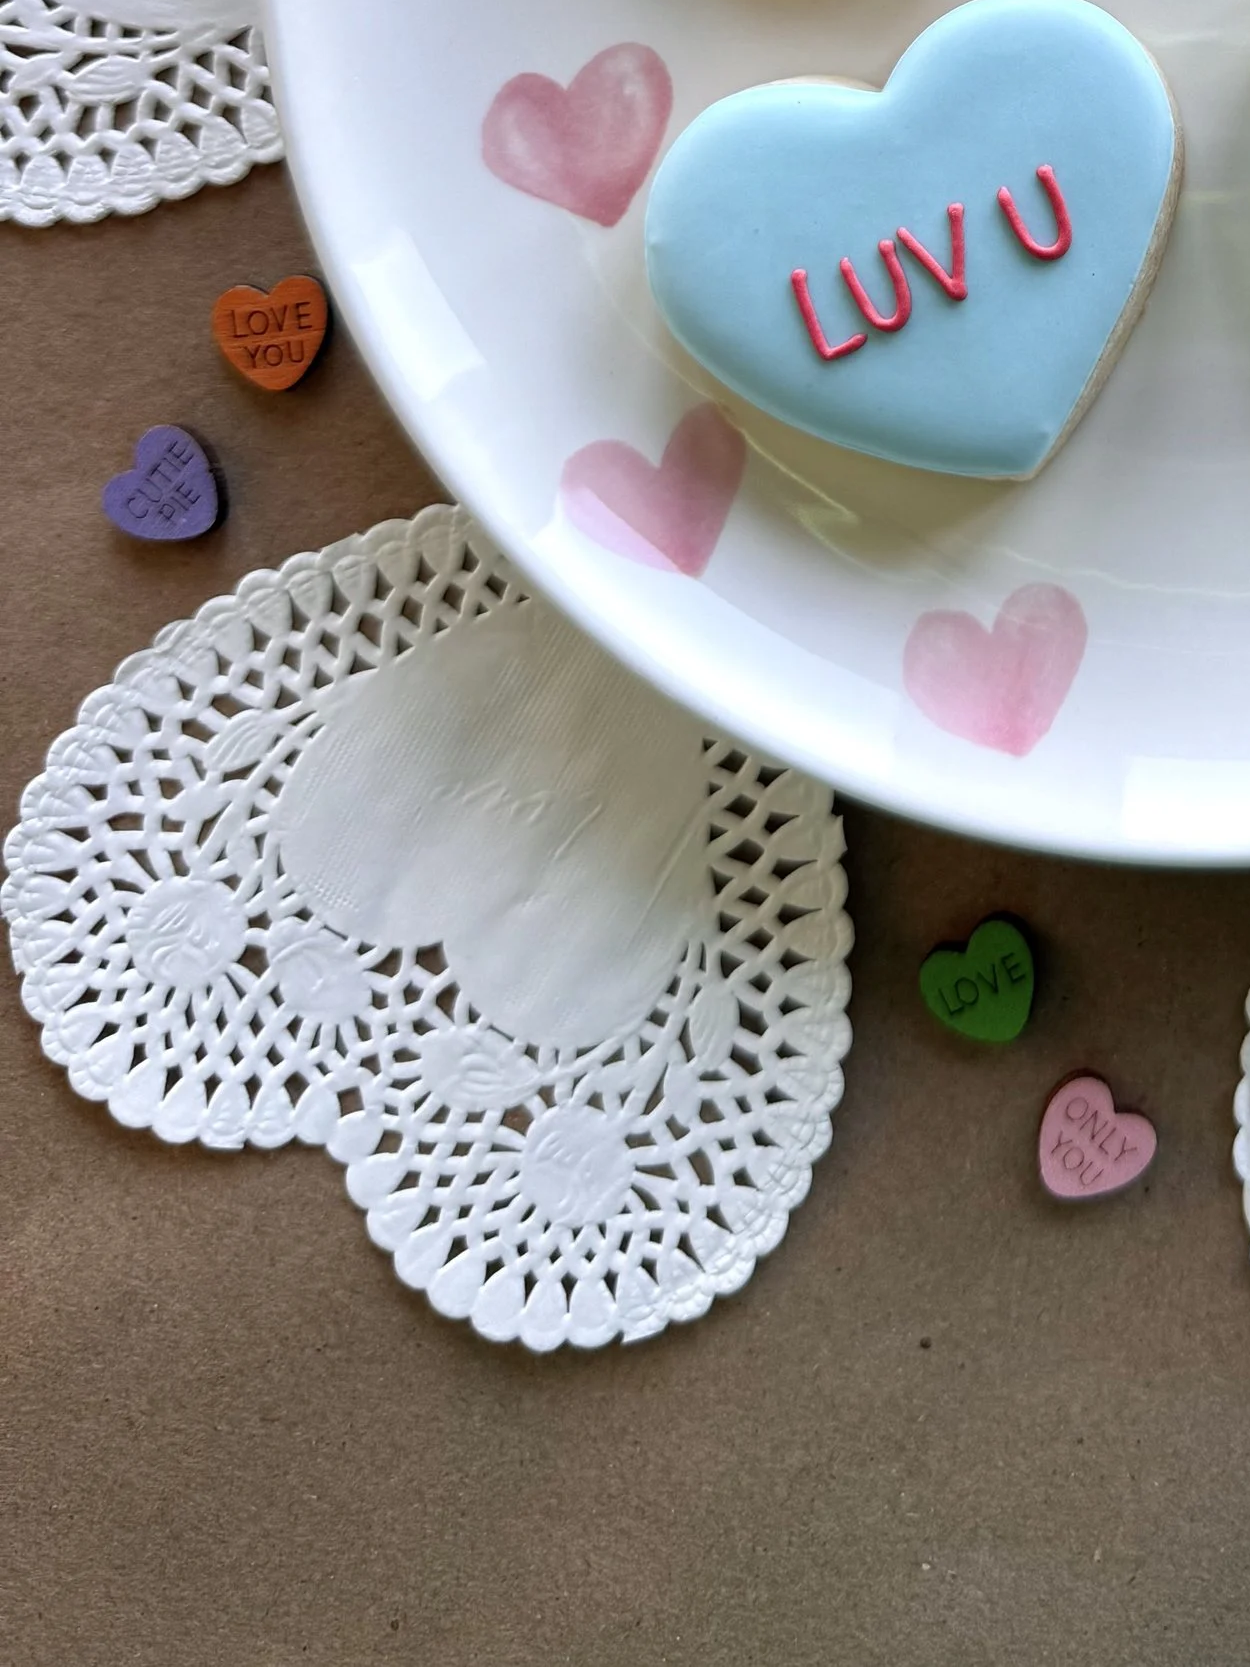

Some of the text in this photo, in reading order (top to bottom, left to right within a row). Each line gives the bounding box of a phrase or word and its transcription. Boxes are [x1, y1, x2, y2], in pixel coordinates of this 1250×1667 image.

[790, 164, 1073, 361] LUV U
[230, 301, 313, 339] LOVE
[243, 340, 304, 369] YOU
[126, 439, 194, 520] CUTIE
[157, 481, 201, 525] PIE
[938, 952, 1027, 1016] LOVE
[1050, 1130, 1103, 1189] YOU
[1065, 1096, 1138, 1162] ONLY
